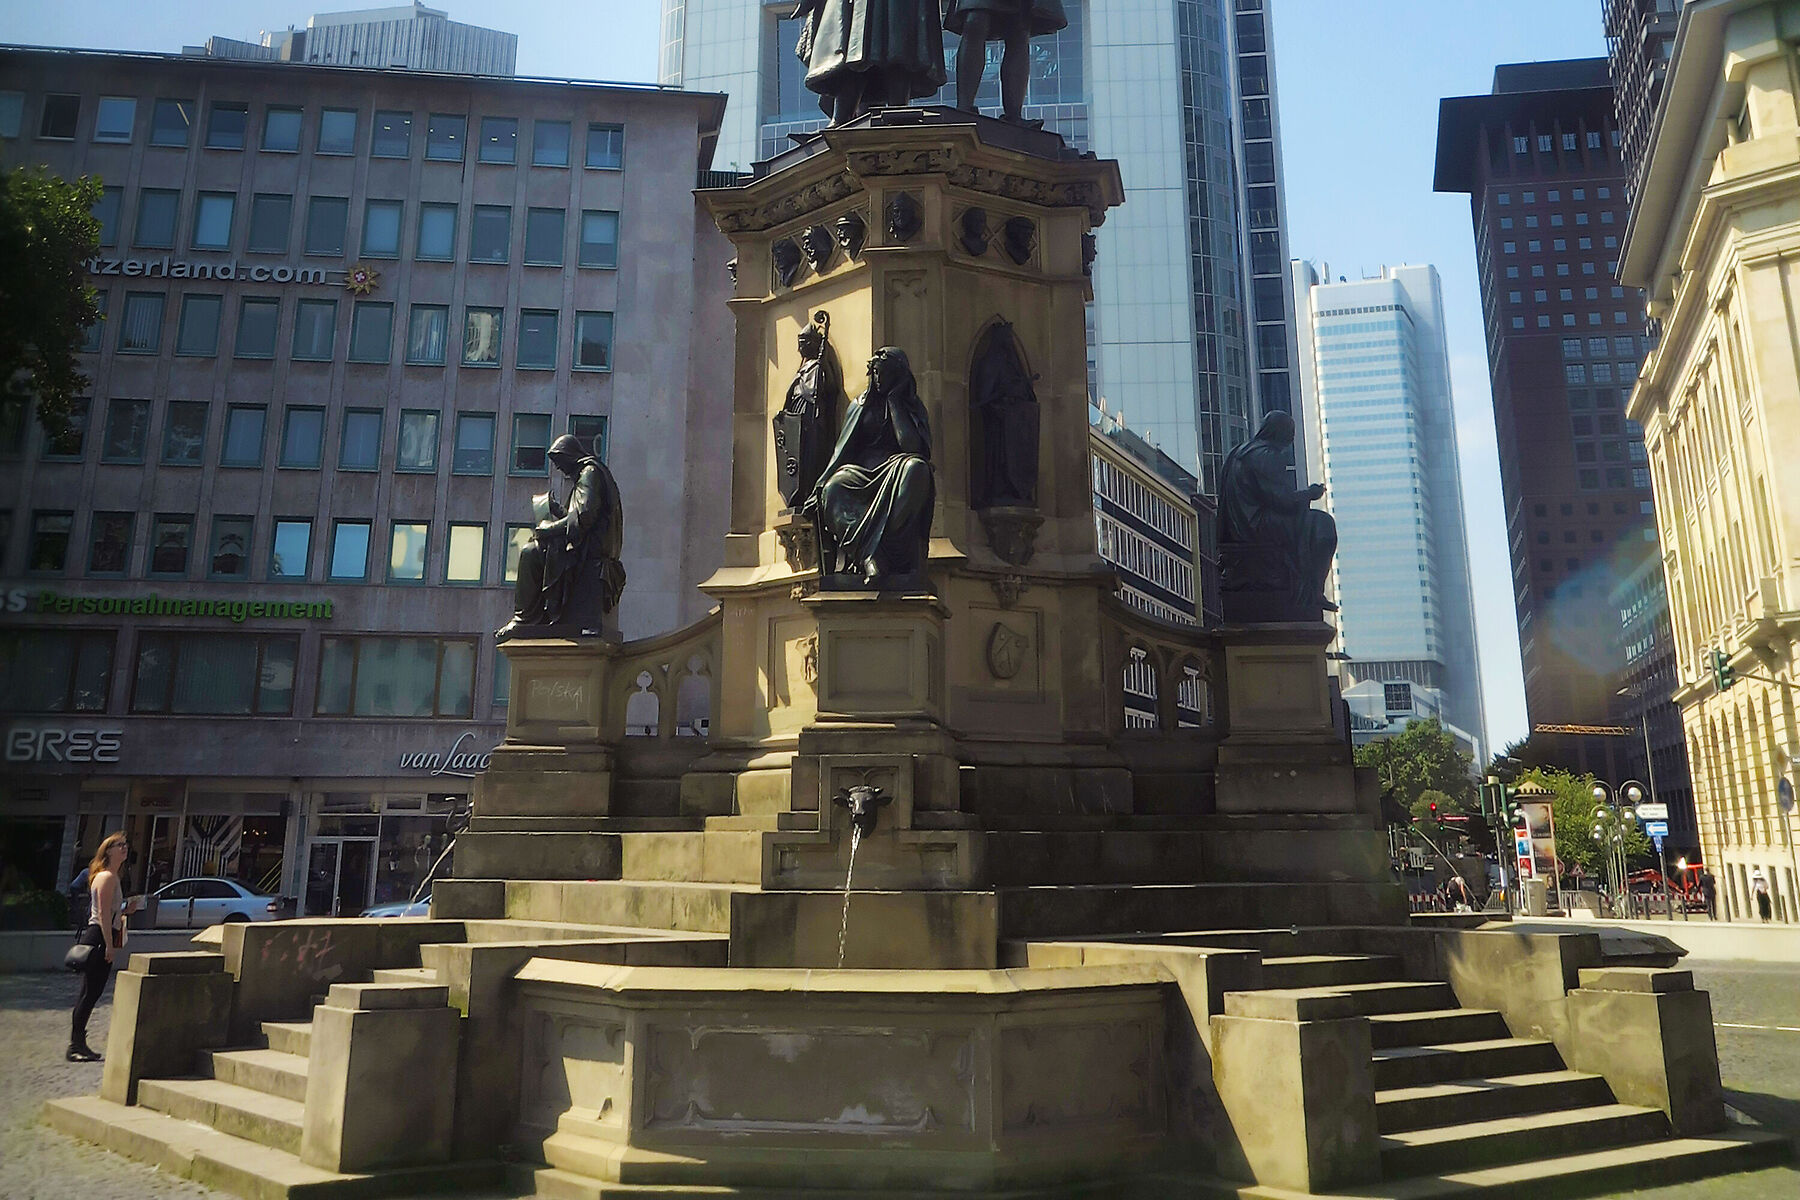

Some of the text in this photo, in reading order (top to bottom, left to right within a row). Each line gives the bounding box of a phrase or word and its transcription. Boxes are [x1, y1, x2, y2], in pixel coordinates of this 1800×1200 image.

[80, 255, 326, 285] tzerland.com
[35, 589, 333, 623] Personalmanagement
[6, 728, 124, 762] BREE
